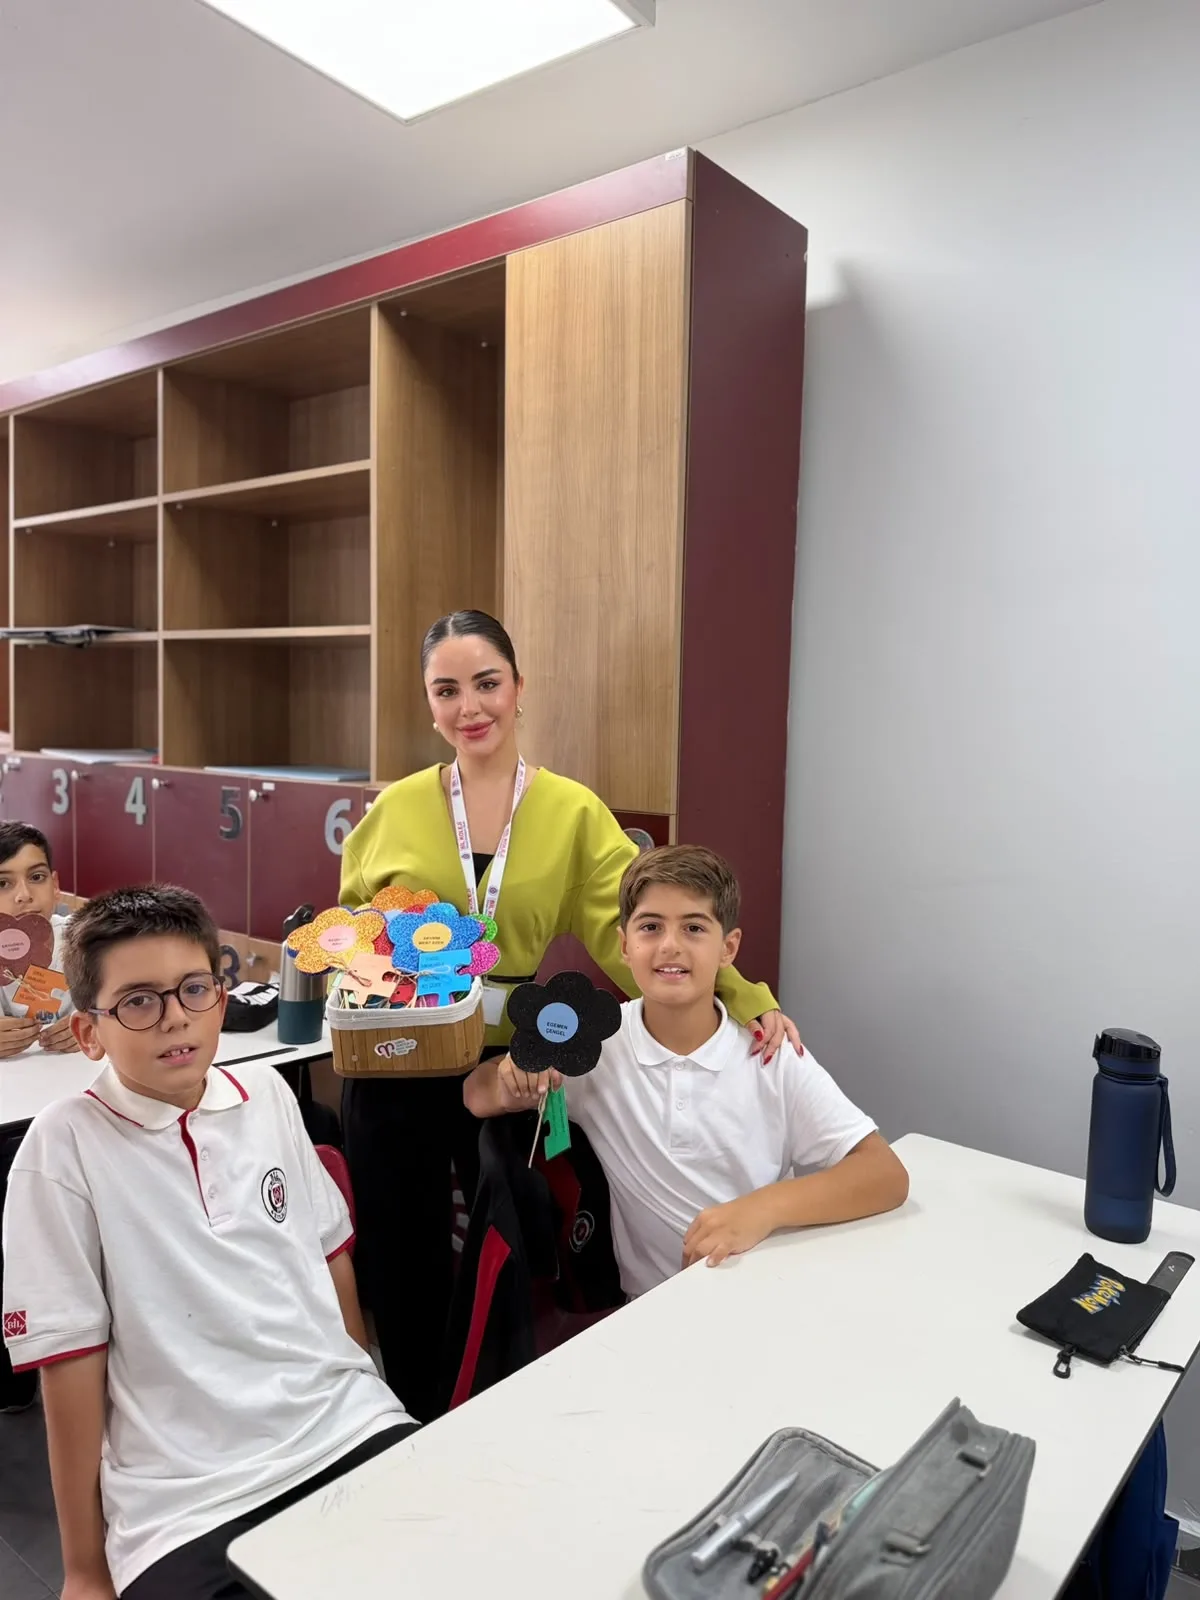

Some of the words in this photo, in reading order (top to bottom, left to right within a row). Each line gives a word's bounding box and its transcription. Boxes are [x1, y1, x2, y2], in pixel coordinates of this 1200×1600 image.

[52, 768, 69, 815] 3
[125, 776, 147, 825] 4
[219, 786, 243, 840] 5
[324, 798, 353, 855] 6
[546, 1021, 568, 1030] EGEMEN
